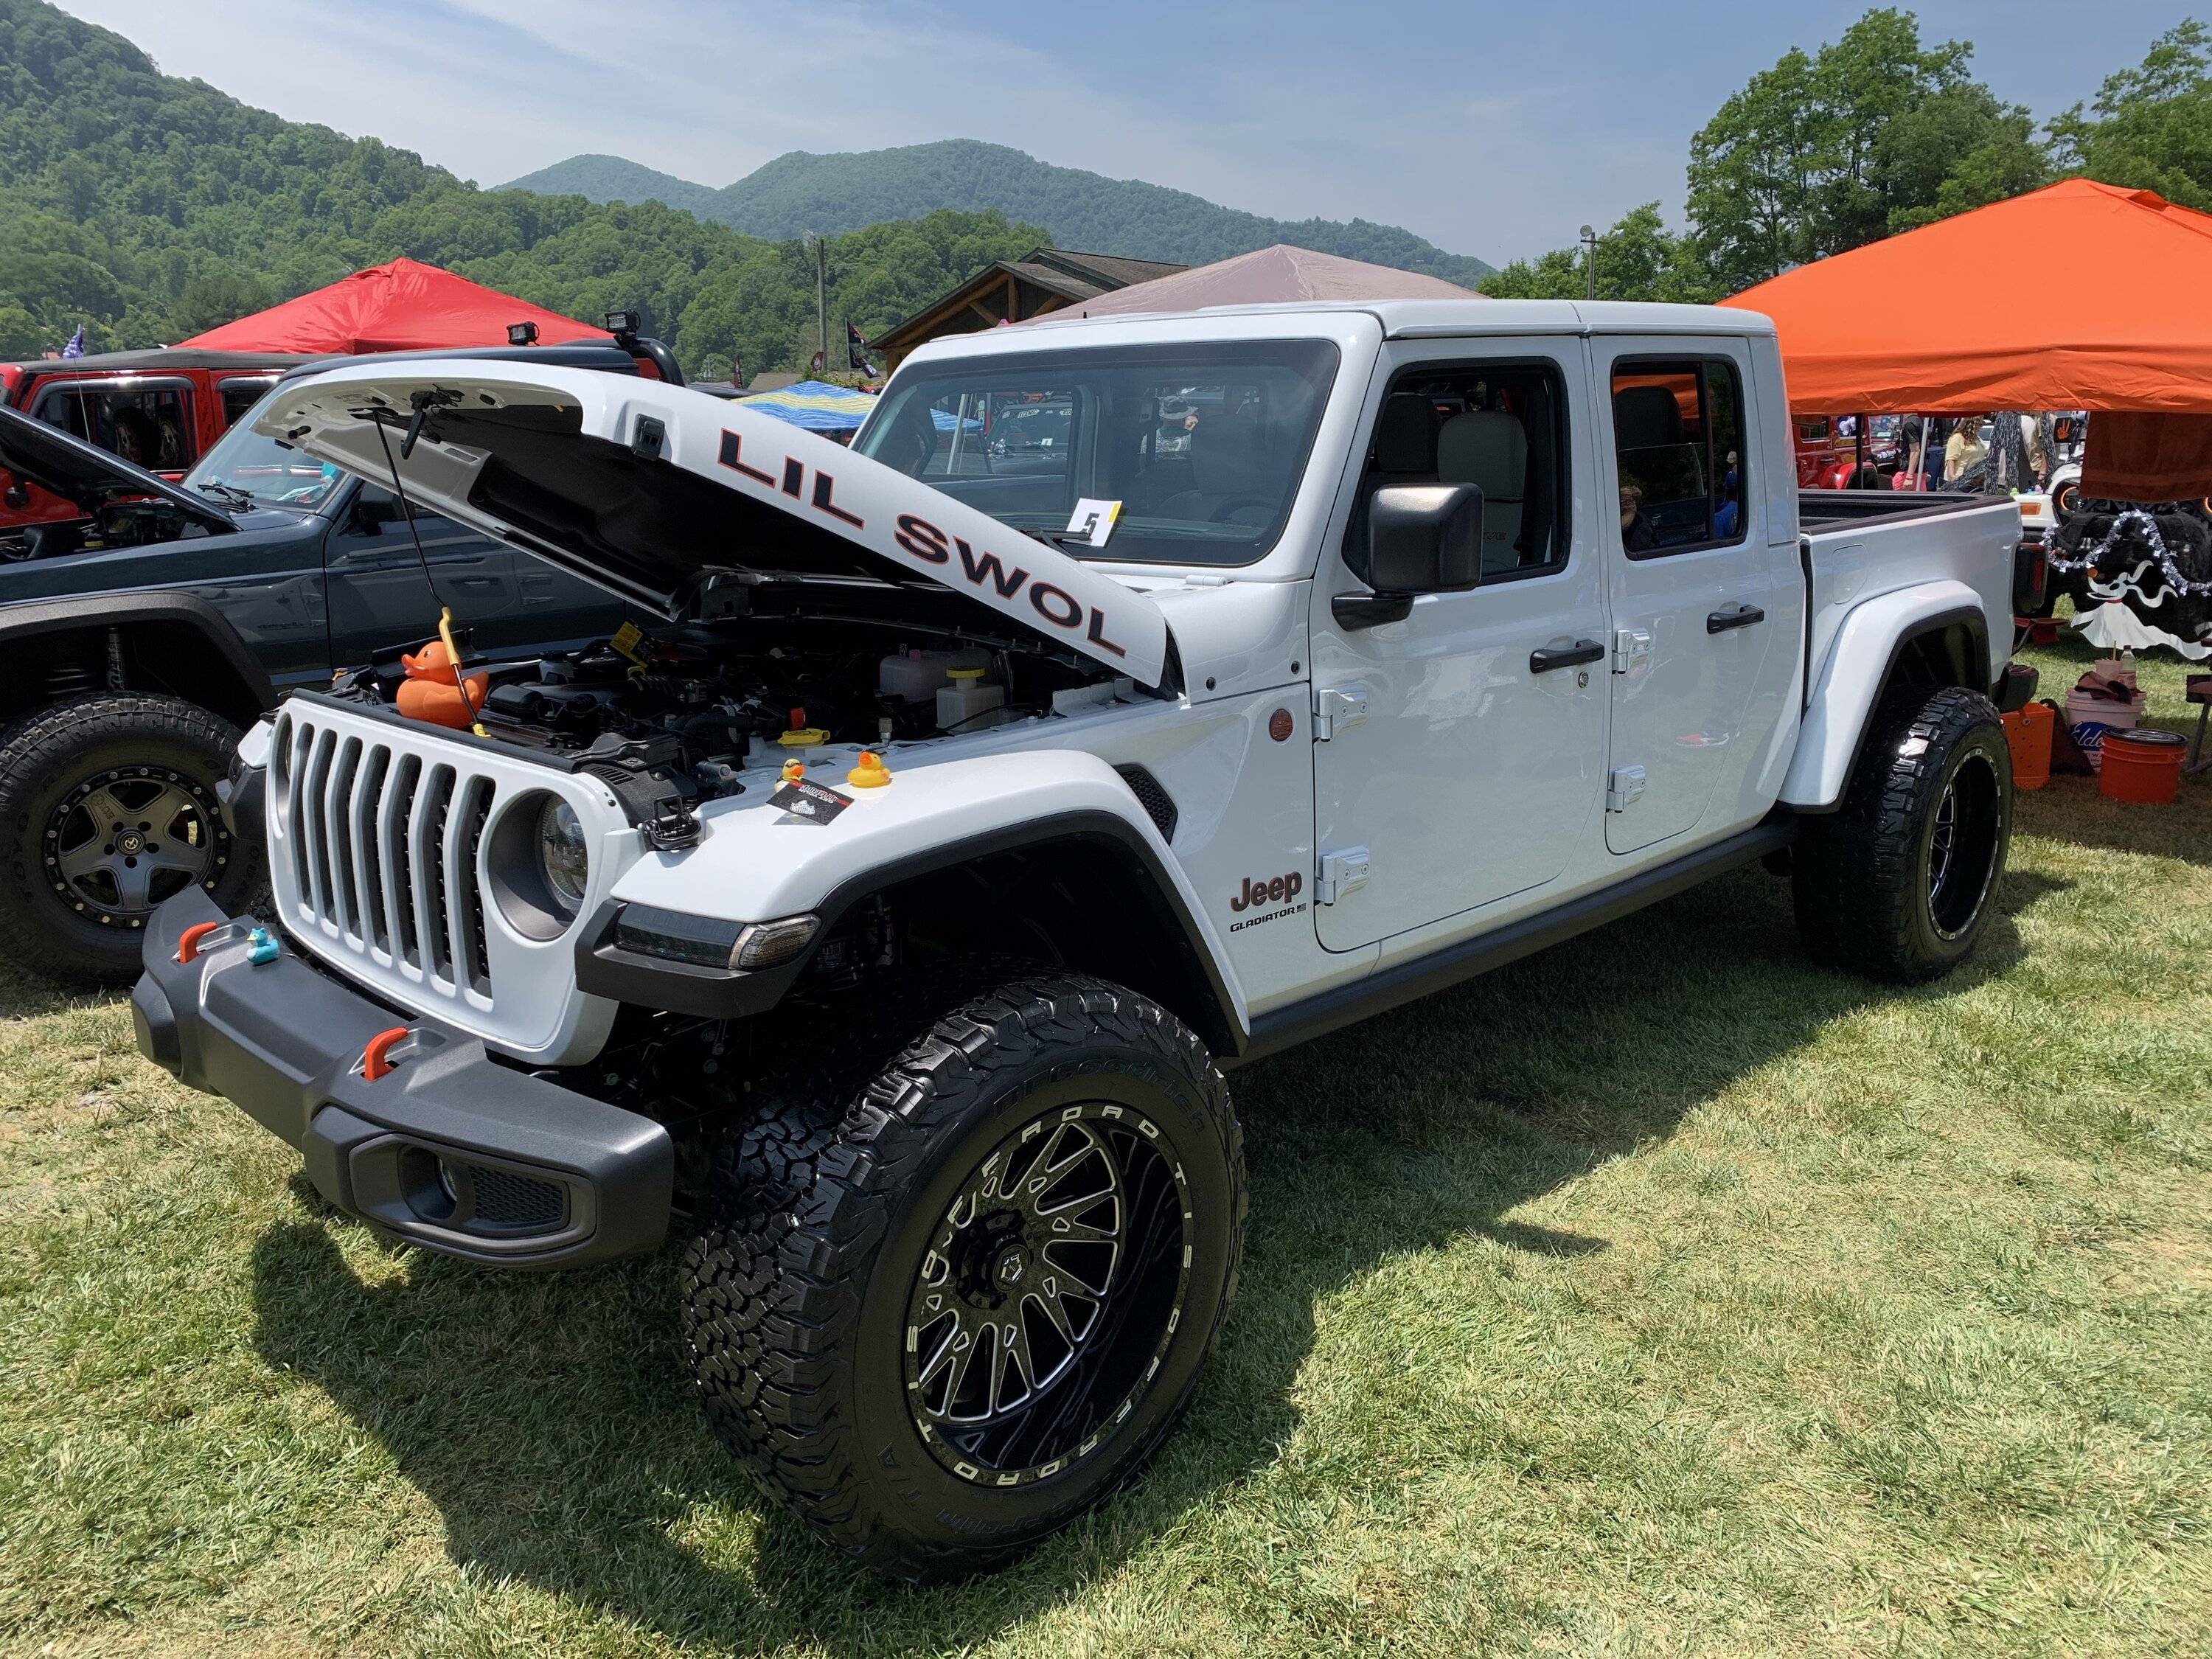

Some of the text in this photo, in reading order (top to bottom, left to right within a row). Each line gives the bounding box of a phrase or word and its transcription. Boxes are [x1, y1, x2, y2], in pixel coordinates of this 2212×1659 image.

[717, 427, 1127, 659] LIL SWOL
[1080, 512, 1100, 540] 5
[1230, 871, 1302, 912] Jeep
[1230, 906, 1295, 933] GLADIATOR
